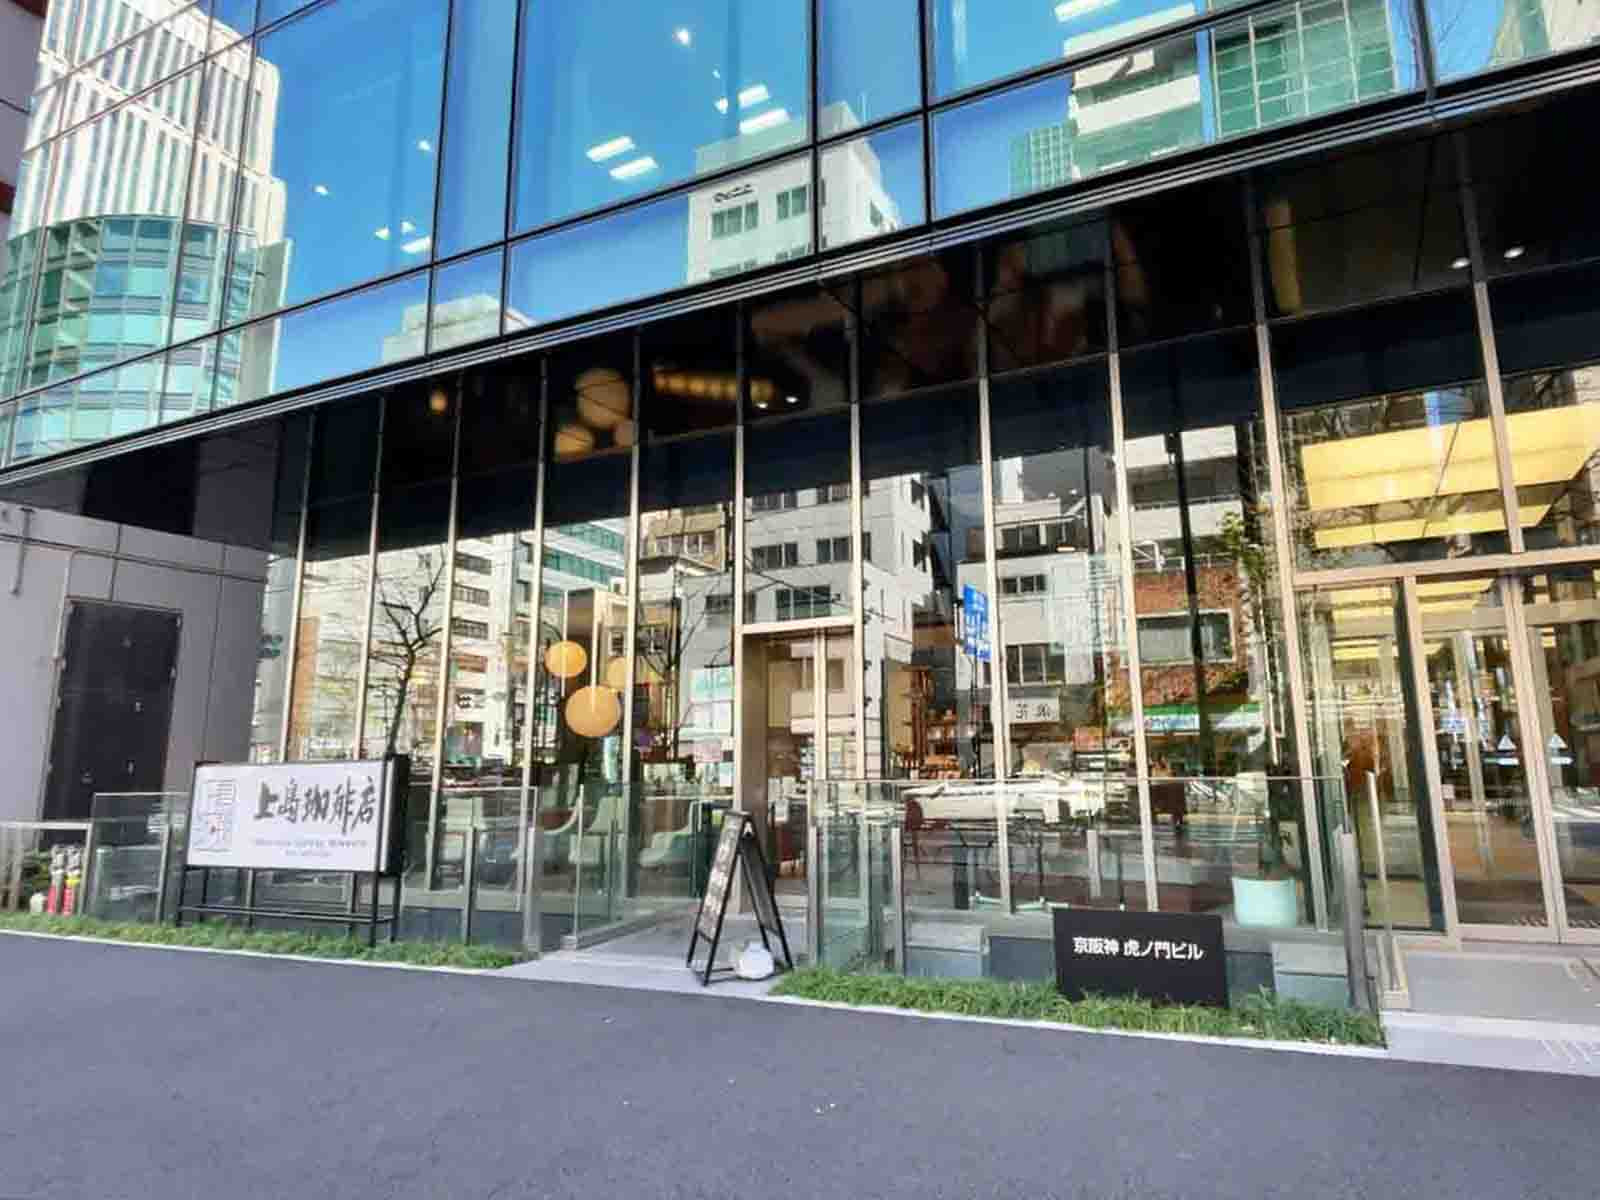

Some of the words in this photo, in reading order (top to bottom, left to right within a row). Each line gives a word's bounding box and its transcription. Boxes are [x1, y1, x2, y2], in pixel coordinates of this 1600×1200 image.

[1073, 936, 1119, 955] 京阪神
[1123, 939, 1204, 959] 虎ノ門ビル
